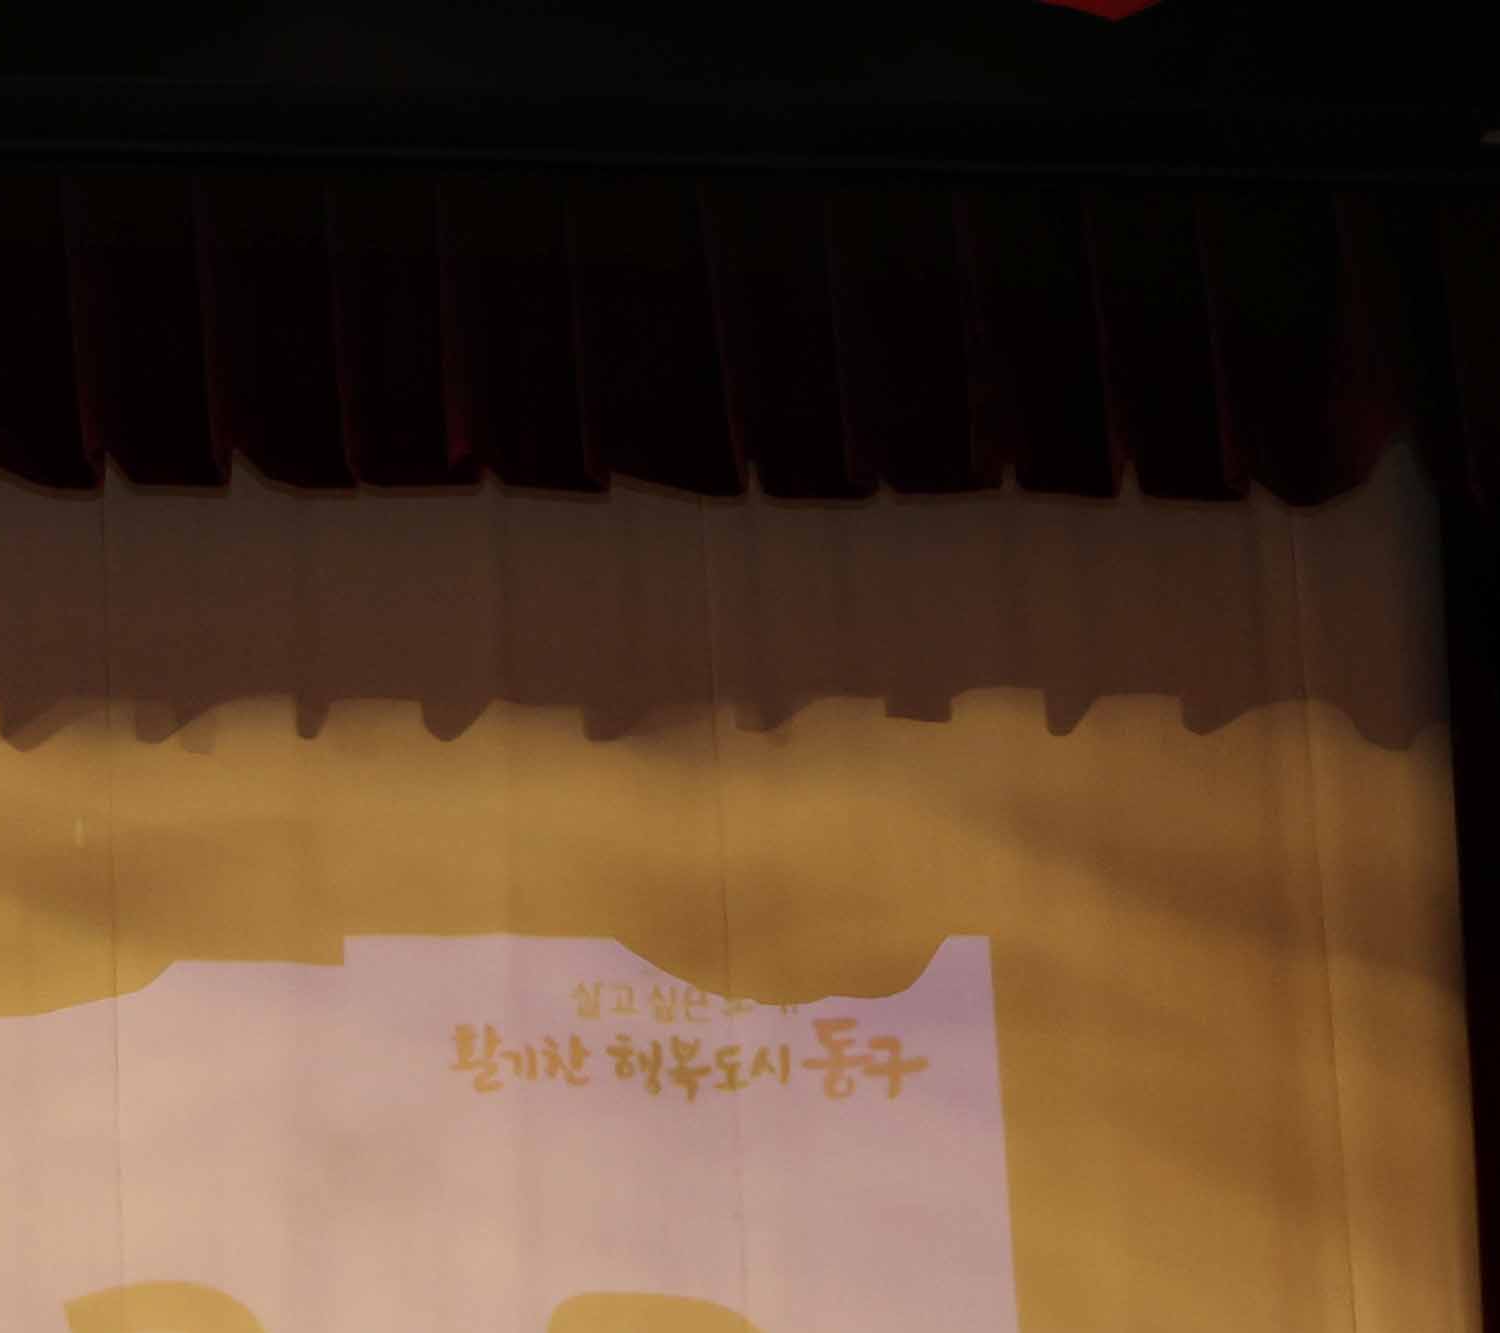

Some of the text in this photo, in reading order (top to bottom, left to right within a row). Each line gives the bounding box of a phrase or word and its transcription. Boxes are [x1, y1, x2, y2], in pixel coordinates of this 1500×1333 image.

[452, 1018, 929, 1101] 활기찬 행복도시 동구
